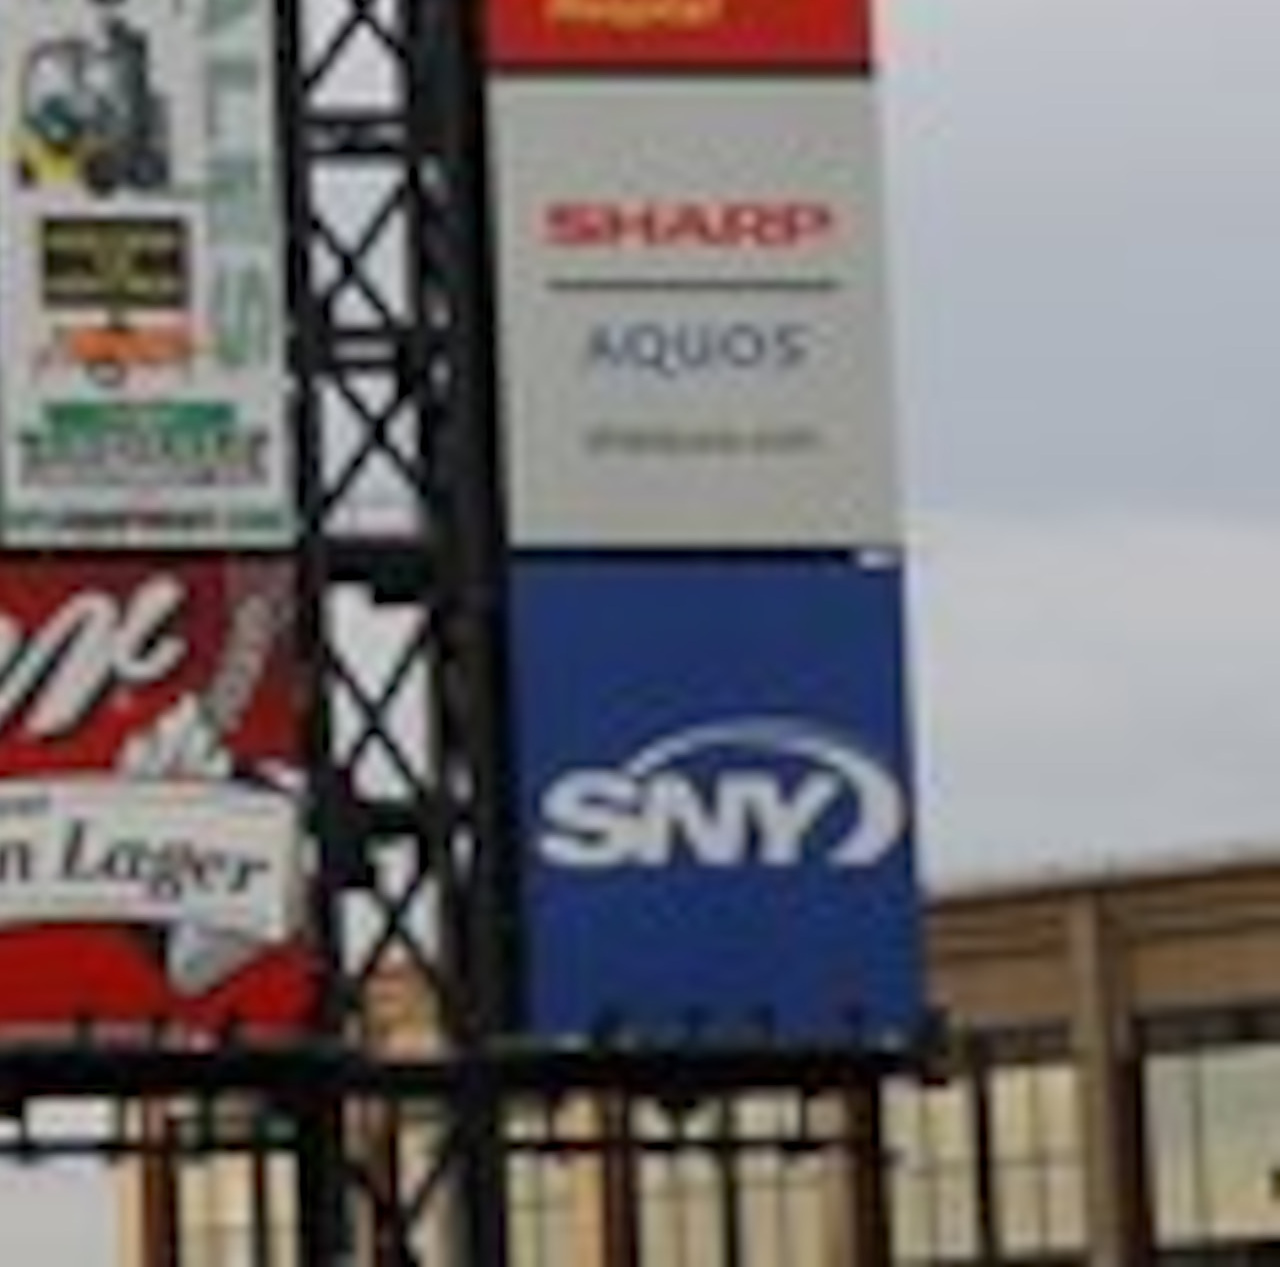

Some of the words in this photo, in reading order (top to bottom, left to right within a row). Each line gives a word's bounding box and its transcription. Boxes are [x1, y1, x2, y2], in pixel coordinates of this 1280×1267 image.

[544, 202, 833, 246] SHARP
[586, 322, 810, 377] AQUOS
[538, 767, 844, 867] SNY
[54, 817, 272, 903] Lager
